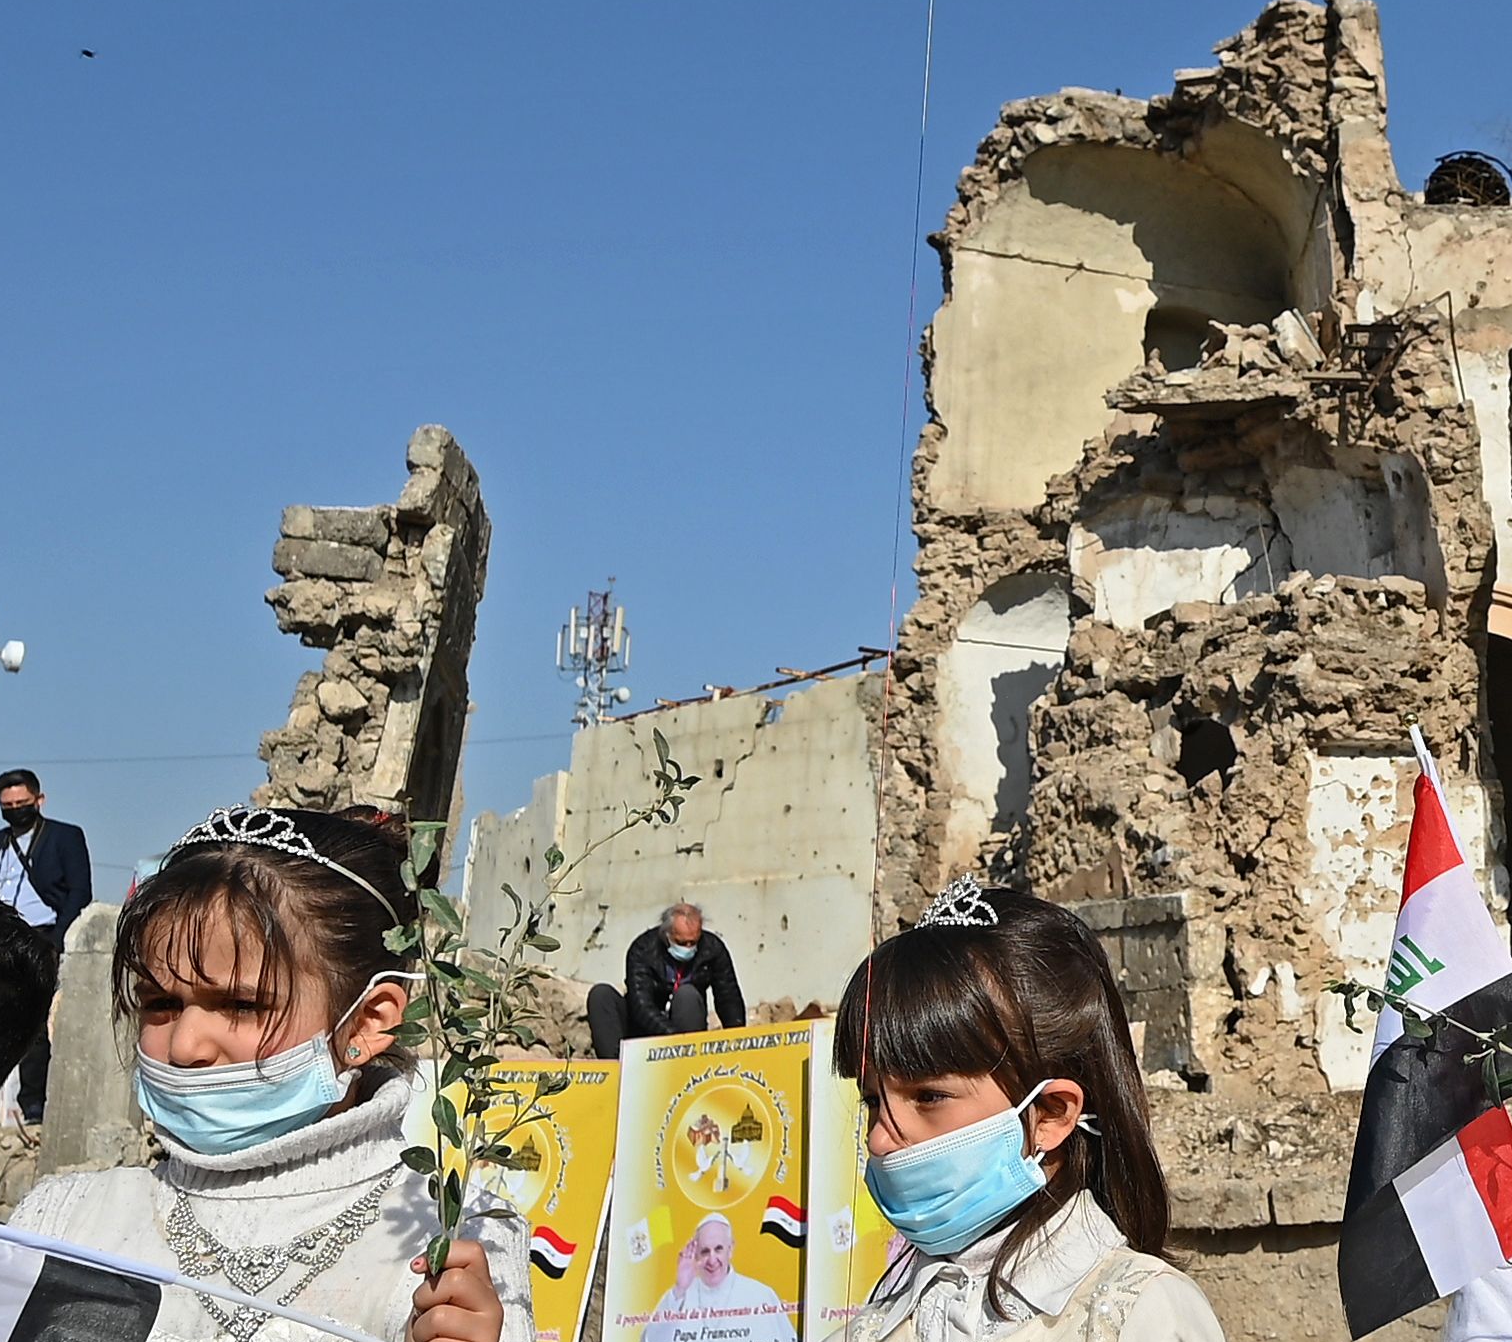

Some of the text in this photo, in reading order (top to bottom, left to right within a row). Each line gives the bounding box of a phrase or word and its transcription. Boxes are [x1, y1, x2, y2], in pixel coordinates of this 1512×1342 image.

[646, 1043, 696, 1062] MOSUL
[700, 1031, 782, 1056] WELCOMES
[576, 1071, 609, 1085] YOU
[699, 1325, 750, 1341] Francesco
